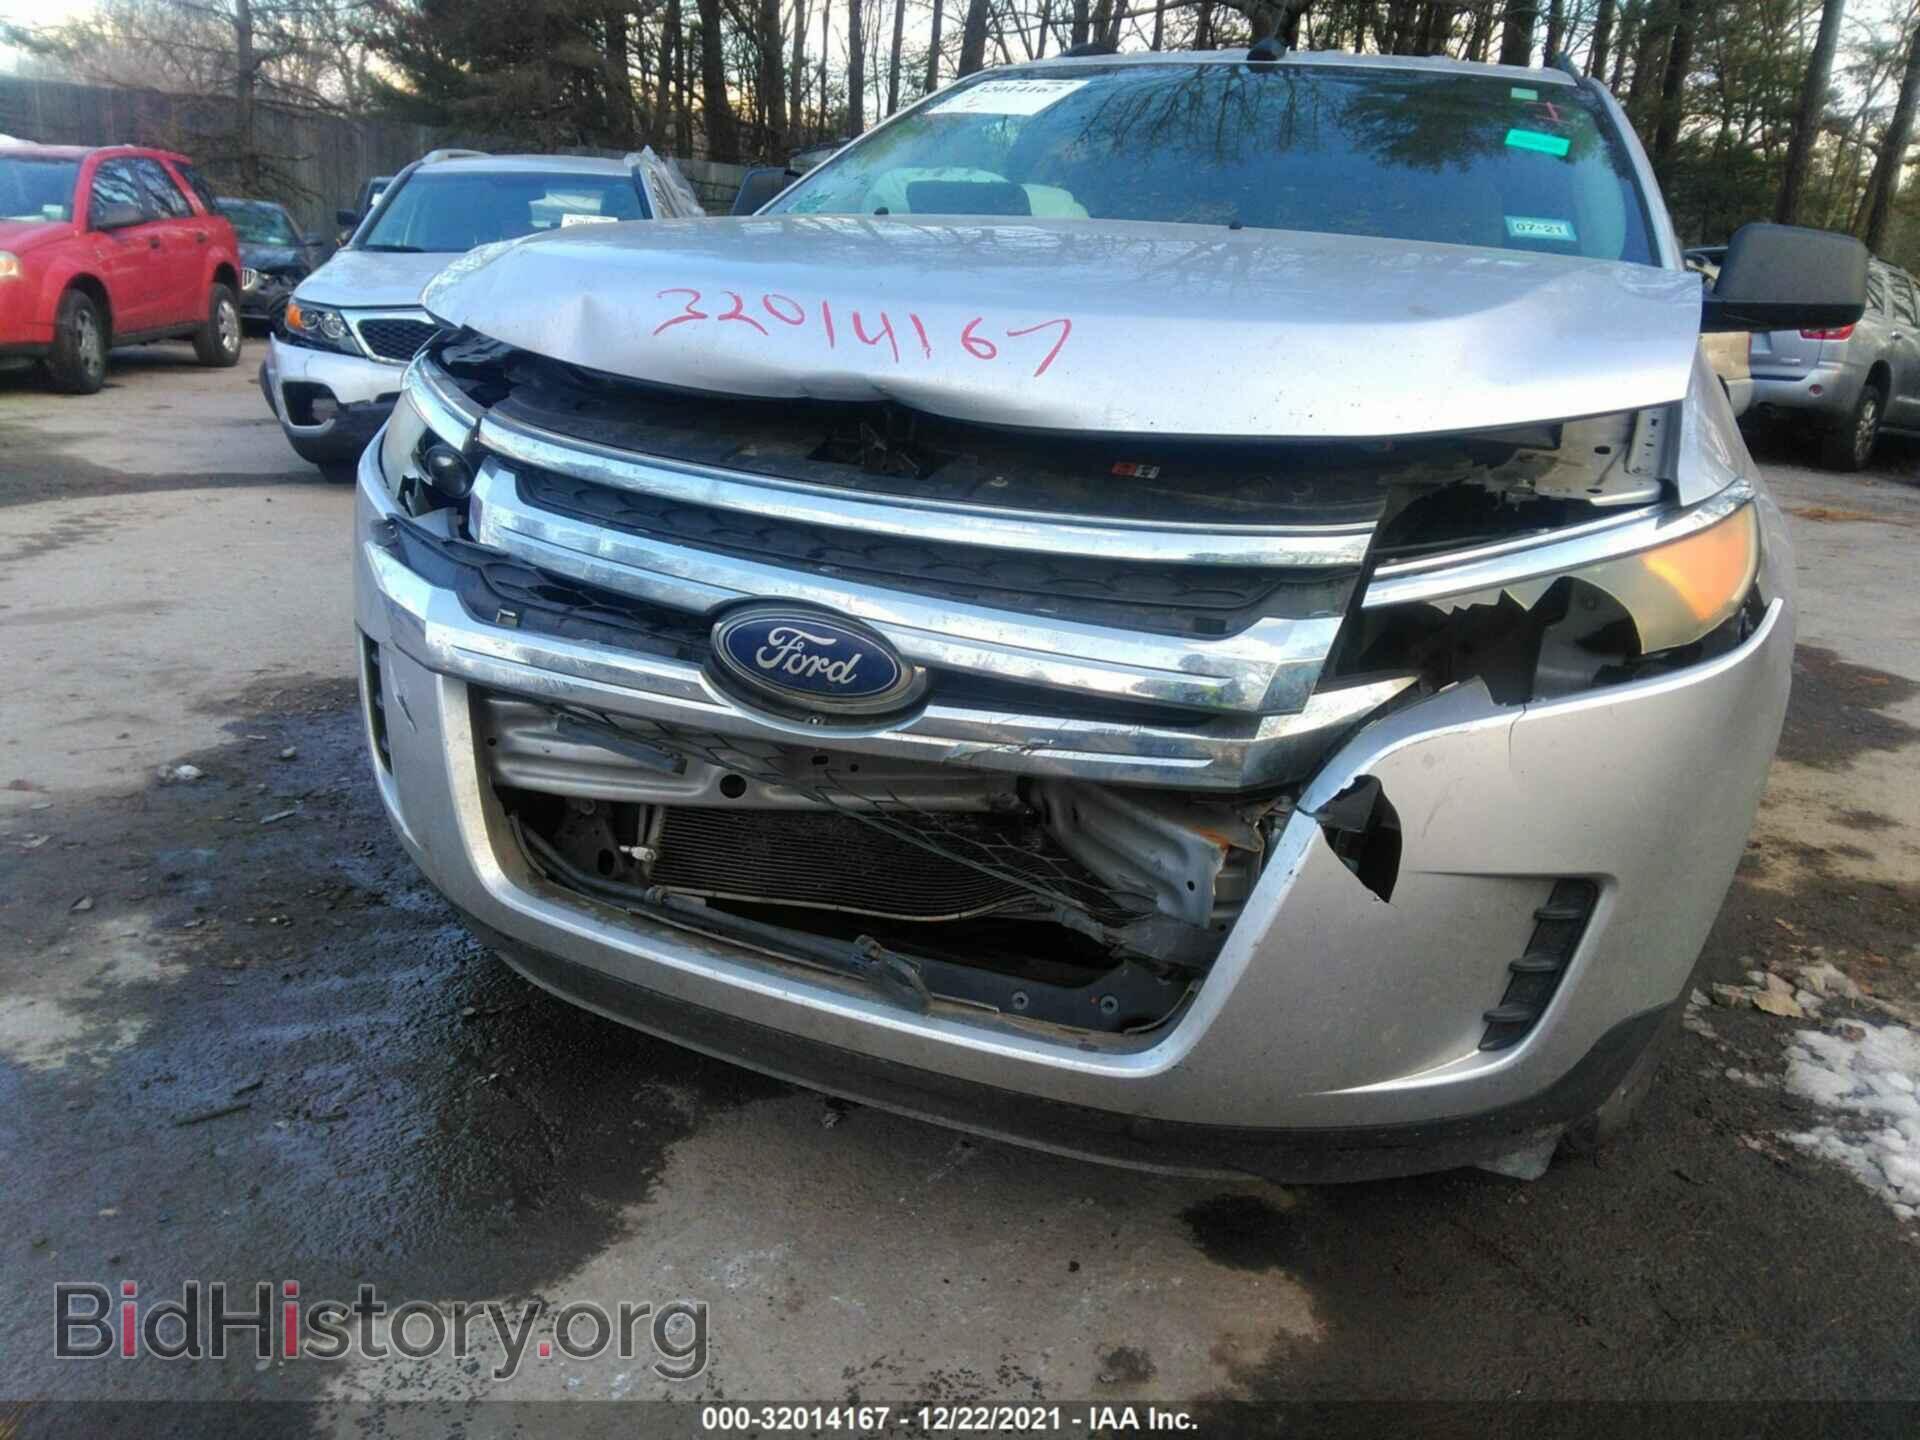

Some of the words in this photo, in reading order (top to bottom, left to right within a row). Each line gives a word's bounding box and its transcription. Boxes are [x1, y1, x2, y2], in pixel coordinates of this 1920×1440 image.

[1515, 222, 1563, 234] 07-21
[653, 288, 1072, 378] 32014167
[755, 626, 863, 685] Ford
